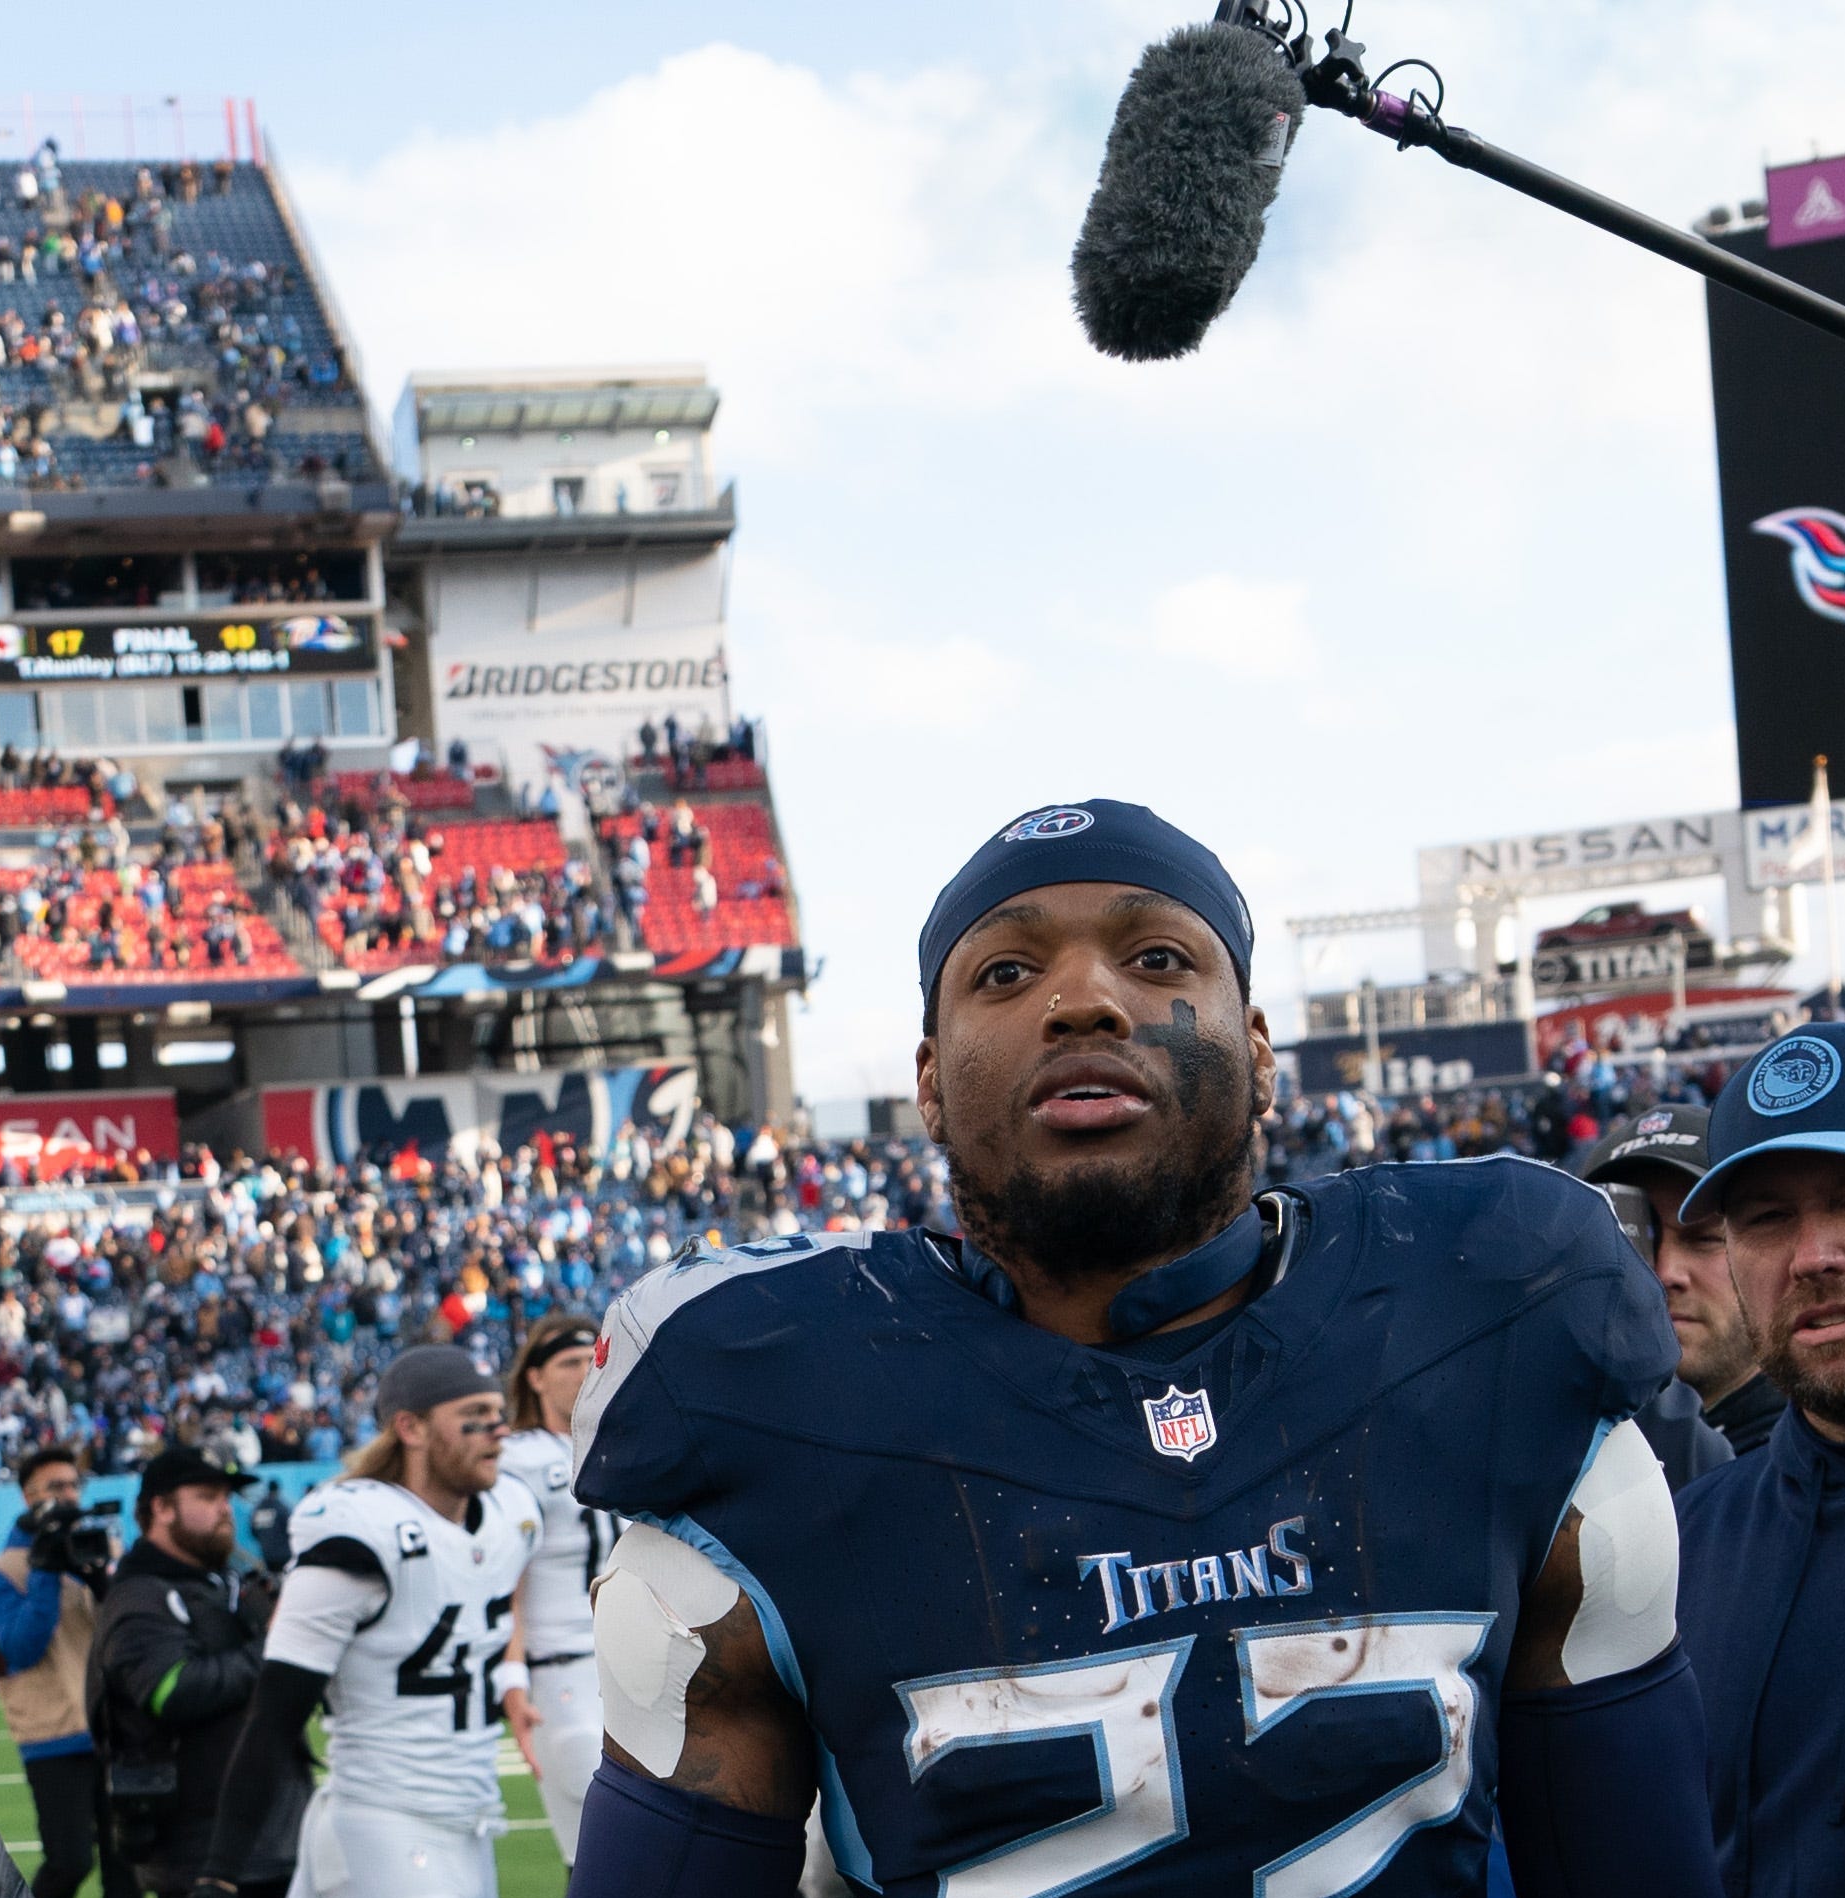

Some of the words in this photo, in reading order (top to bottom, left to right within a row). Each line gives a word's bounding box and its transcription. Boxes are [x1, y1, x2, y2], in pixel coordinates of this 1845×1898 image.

[113, 626, 197, 653] FINAL
[447, 658, 724, 699] BRIDGESTONE
[1461, 817, 1713, 873] NISSAN
[1160, 1413, 1207, 1448] NFL
[1076, 1516, 1314, 1634] TITANS
